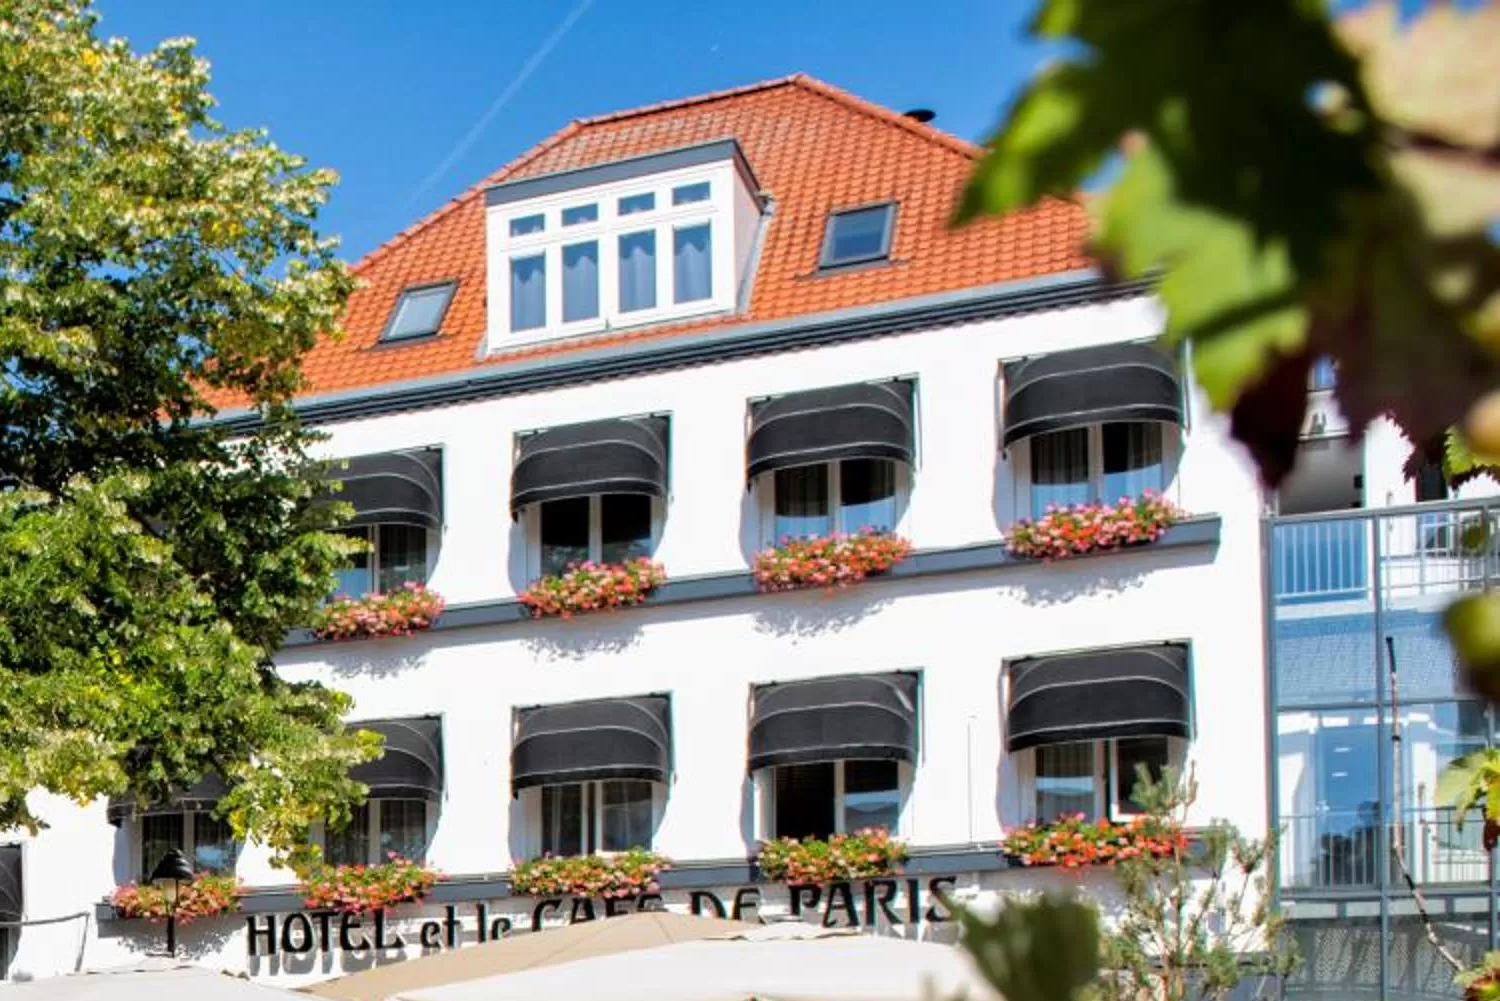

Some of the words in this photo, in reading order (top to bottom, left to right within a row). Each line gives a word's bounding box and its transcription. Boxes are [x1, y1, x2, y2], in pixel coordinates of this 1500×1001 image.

[246, 908, 408, 956] HOTEL
[419, 904, 461, 950] et
[477, 903, 511, 944] le
[688, 887, 766, 925] DE
[788, 876, 957, 927] PARIS
